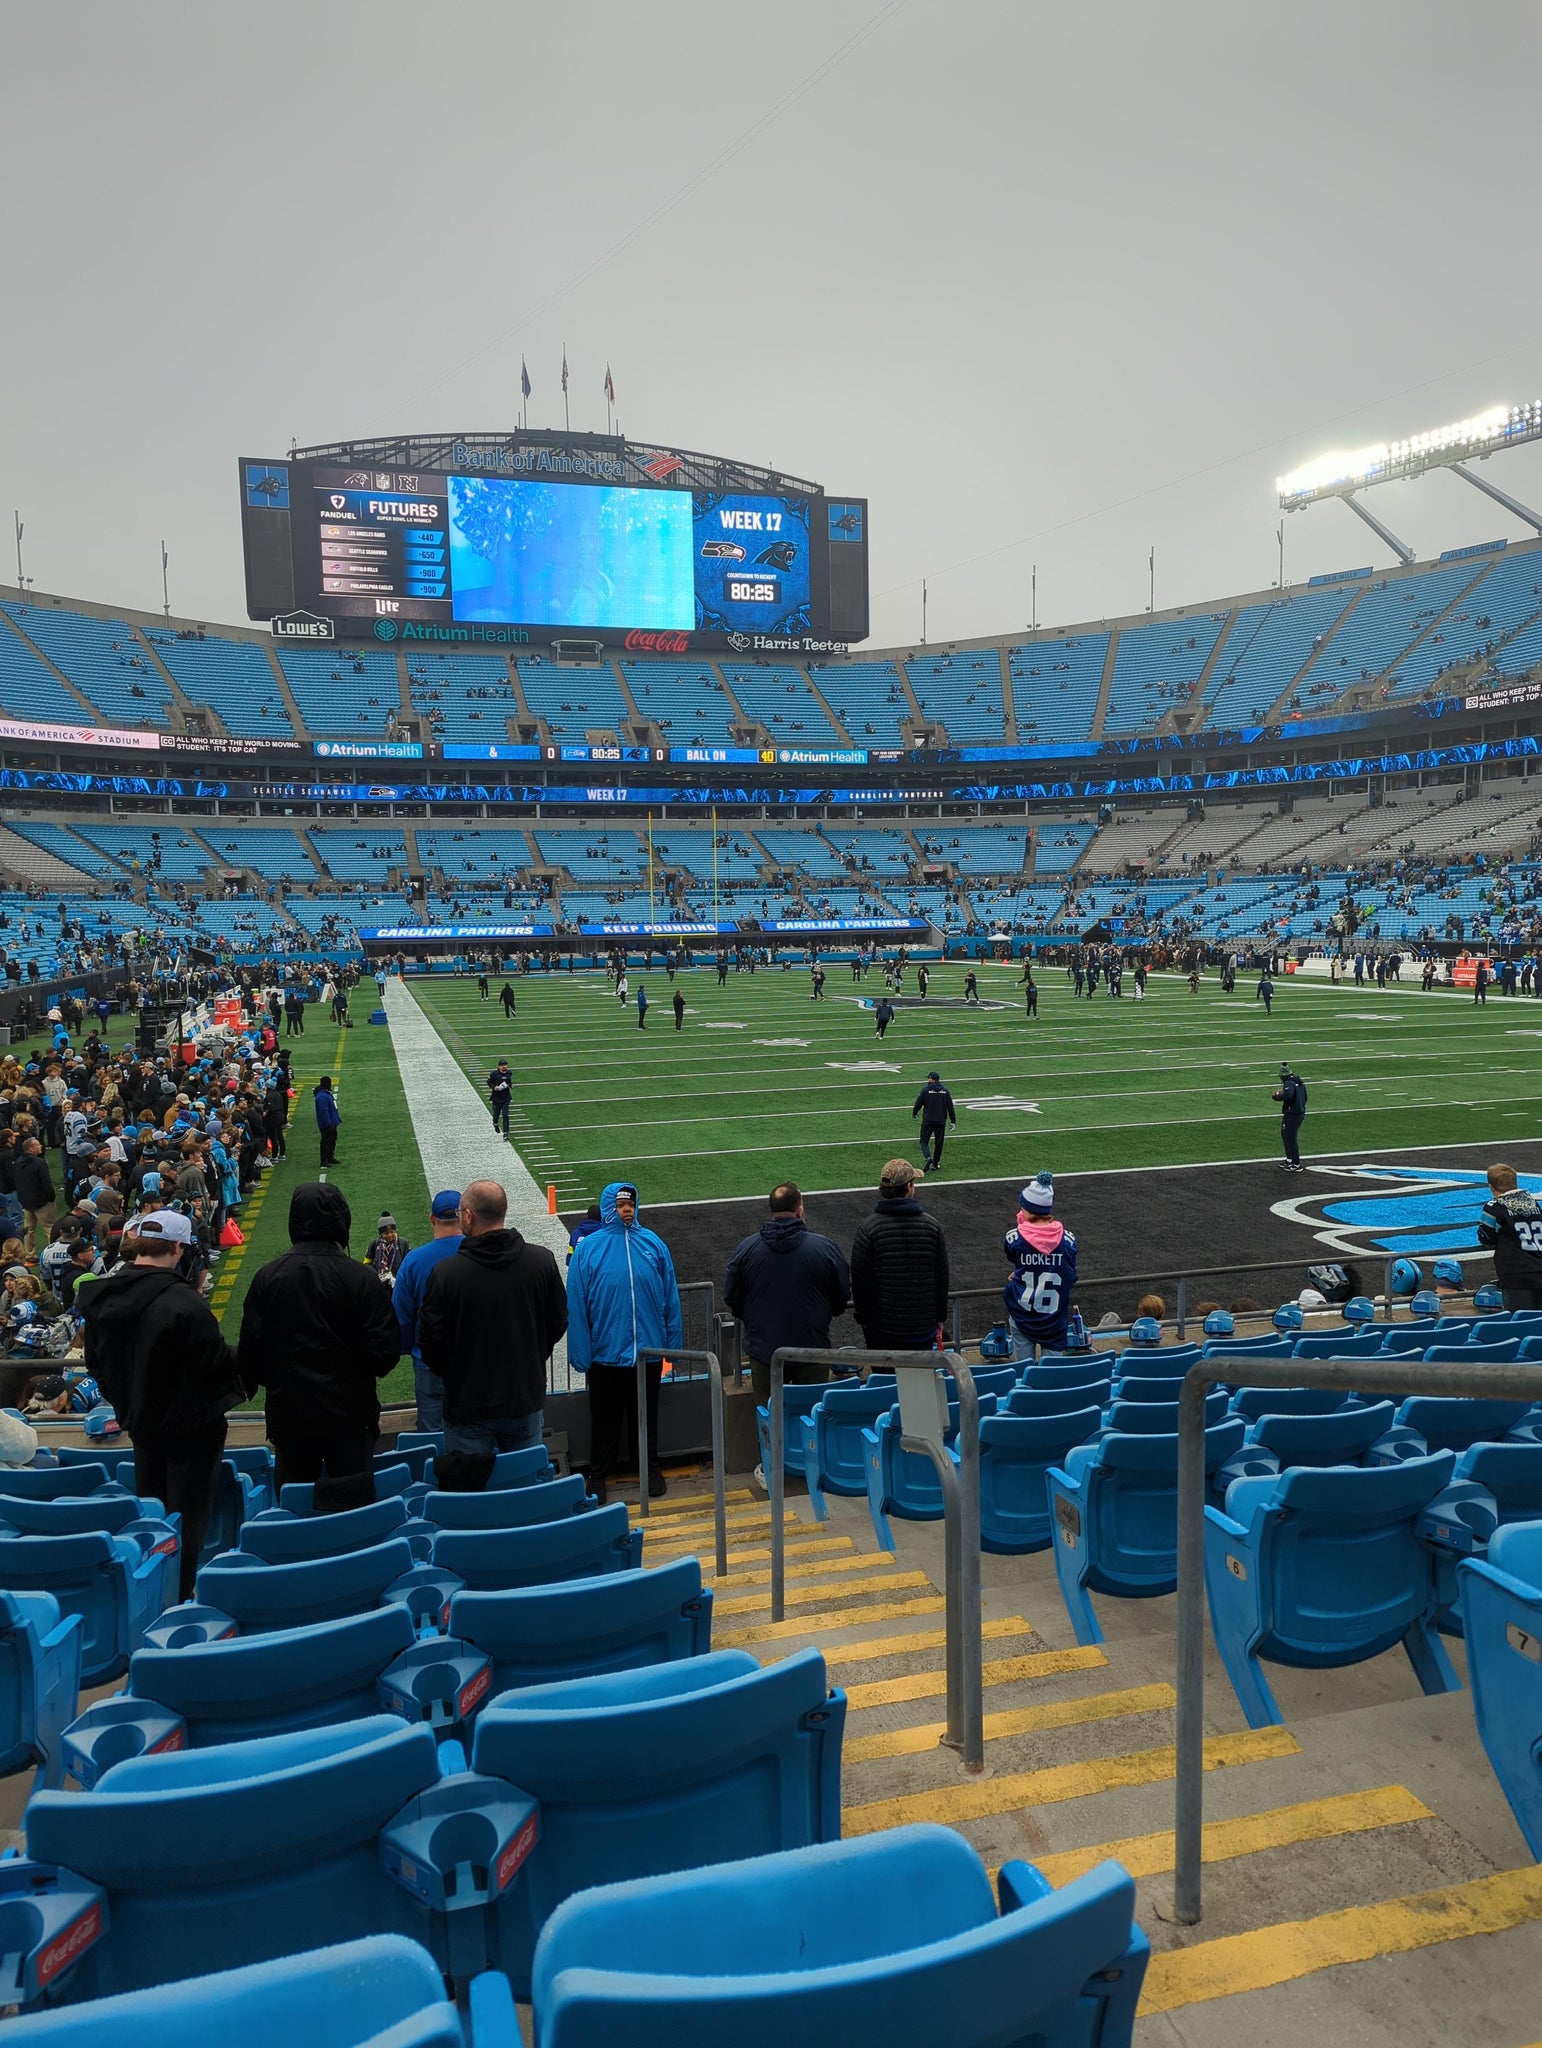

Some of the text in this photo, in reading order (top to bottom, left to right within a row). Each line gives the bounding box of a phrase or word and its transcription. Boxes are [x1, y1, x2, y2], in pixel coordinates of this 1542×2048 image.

[452, 444, 625, 477] Bank of America
[369, 500, 438, 518] FUTURES
[320, 511, 356, 520] FANDUEL
[720, 510, 782, 531] WEEK 17
[731, 583, 774, 600] 80:25
[376, 600, 400, 614] Lite
[278, 620, 328, 636] LOWE'S
[402, 622, 529, 643] Atrium Health
[754, 636, 848, 652] Harris Teeter
[1493, 690, 1508, 698] WHO
[1509, 687, 1526, 696] KEEP
[1528, 684, 1540, 692] THE
[18, 728, 29, 736] OF
[32, 730, 74, 740] AMERICA
[98, 736, 140, 745] STADIUM
[331, 744, 418, 756] Atrium Health
[489, 746, 498, 758] &
[548, 748, 554, 759] 0
[592, 748, 620, 760] 80:25
[656, 750, 664, 760] 0
[686, 750, 726, 761] BALL ON
[791, 751, 830, 762] Atrium
[831, 752, 865, 762] Health
[587, 789, 627, 800] WEEK 17
[644, 924, 716, 932] POUNDING
[776, 919, 910, 930] CAROLINA PANTHERS
[377, 926, 534, 936] CAROLINA PANTHERS
[272, 942, 282, 952] 12
[1020, 1253, 1063, 1266] LOCKETT
[1018, 1272, 1062, 1314] 16
[1518, 1631, 1528, 1650] 7
